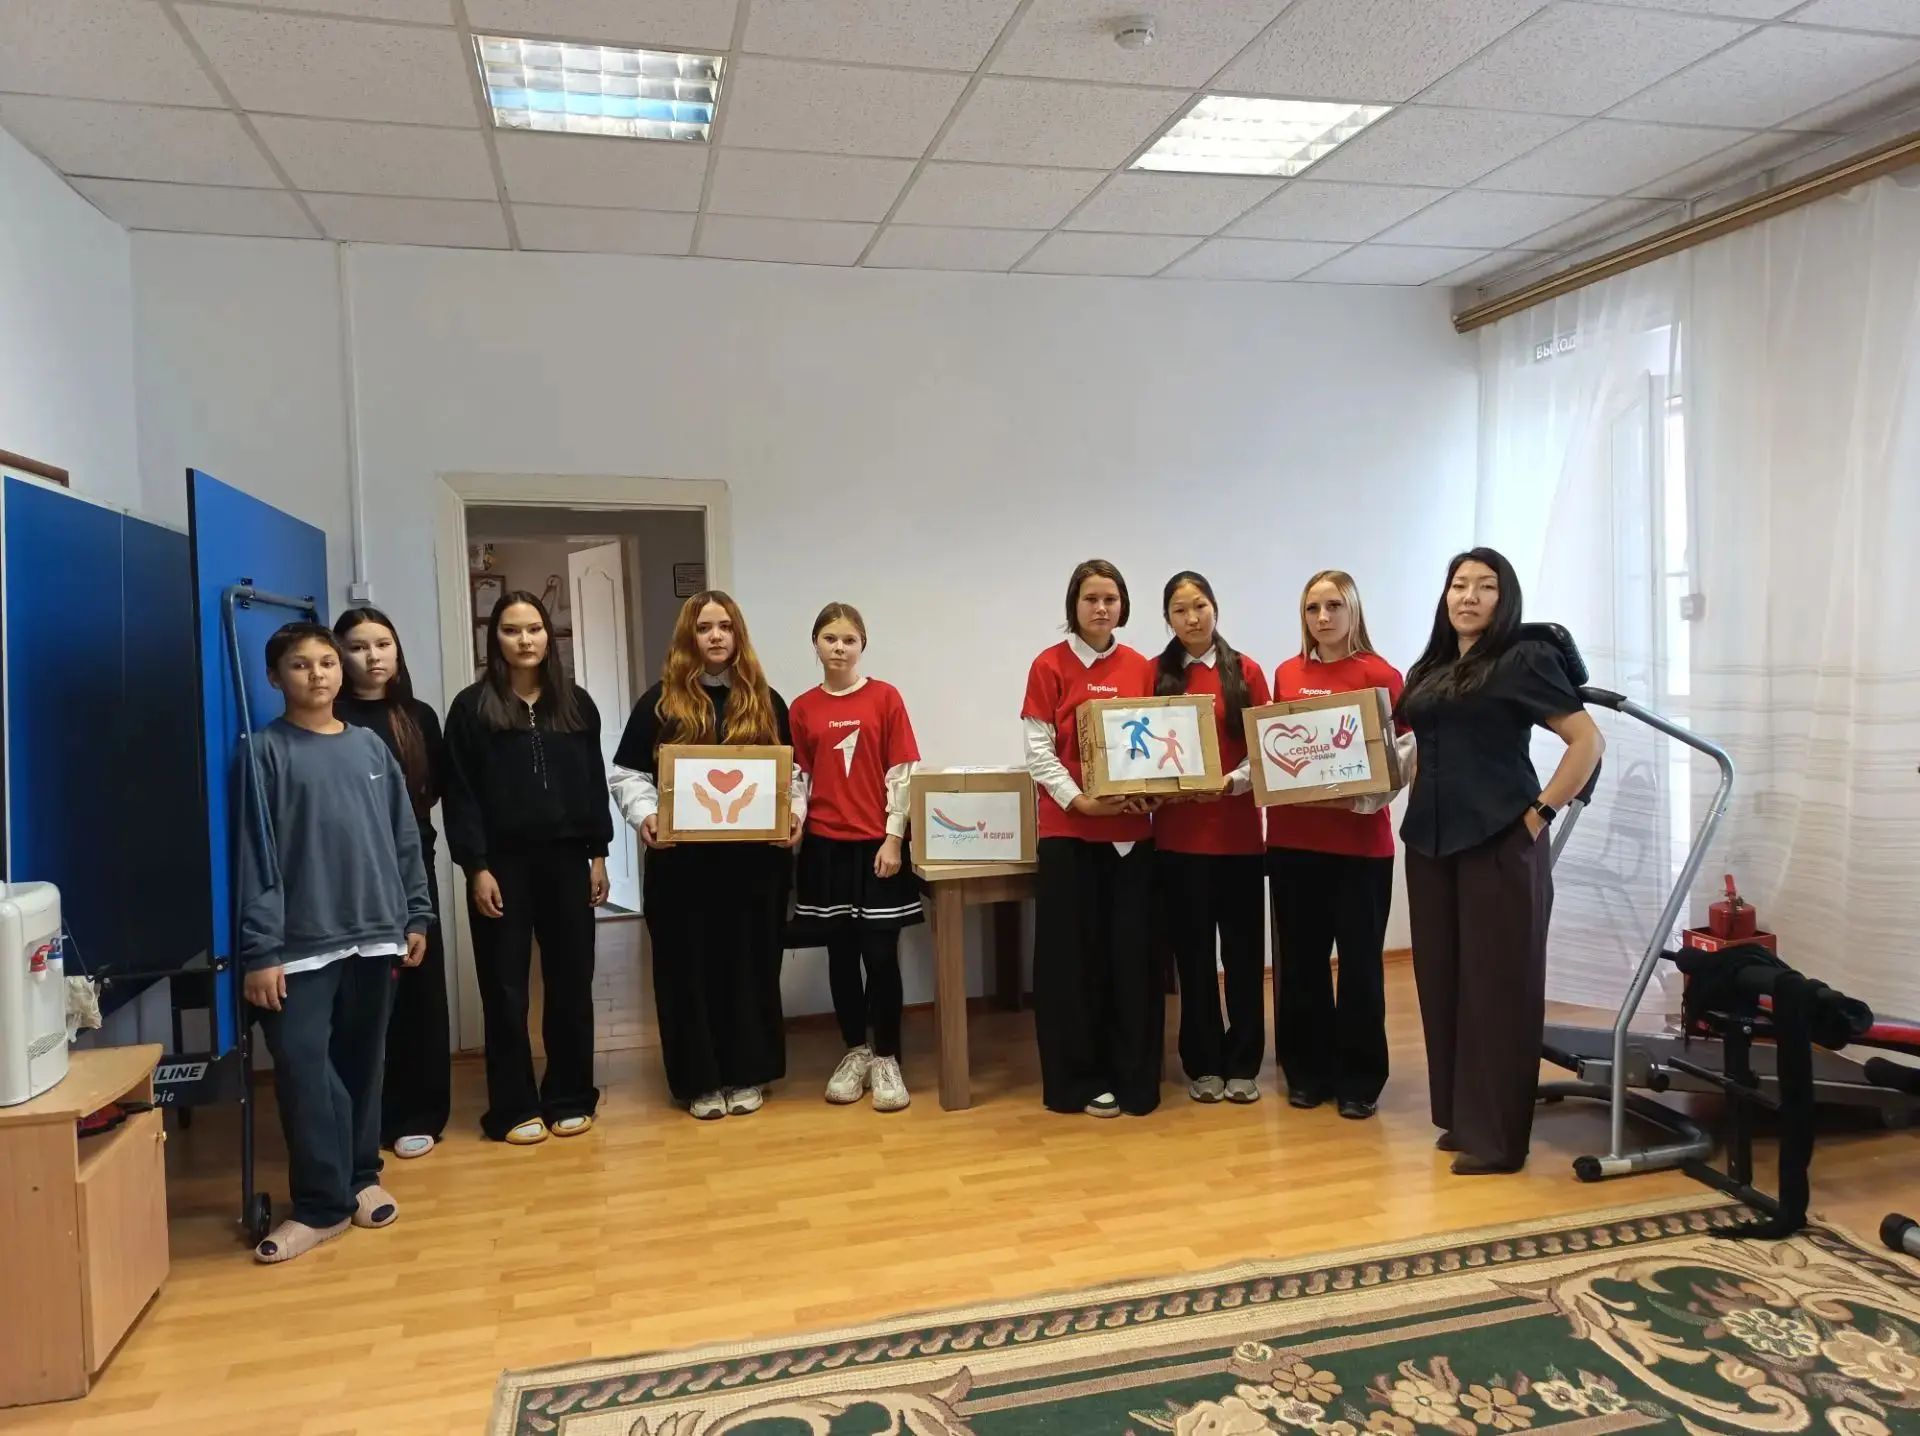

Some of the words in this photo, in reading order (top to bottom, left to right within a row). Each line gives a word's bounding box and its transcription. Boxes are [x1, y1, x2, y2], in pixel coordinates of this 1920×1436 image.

[1087, 683, 1118, 693] Первые
[1298, 688, 1331, 696] Первые
[829, 720, 860, 728] Первые
[1289, 743, 1330, 756] сердца
[158, 1065, 202, 1081] LINE
